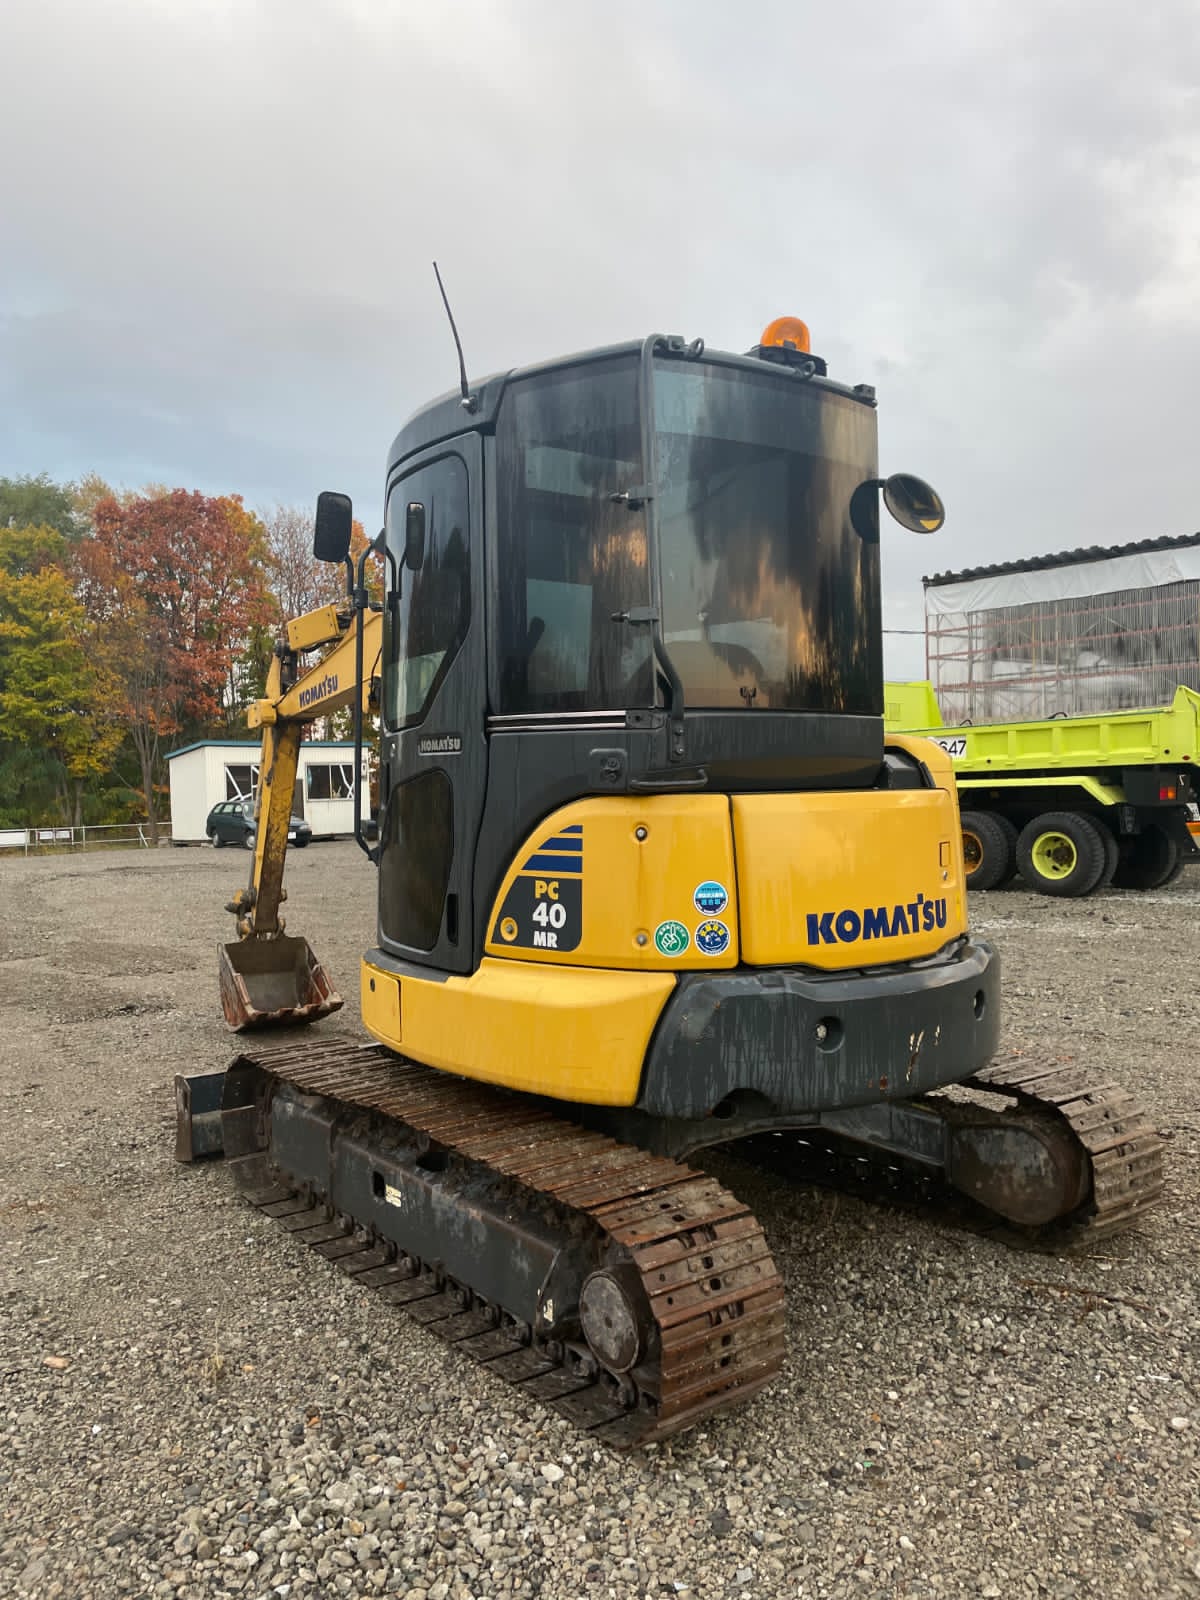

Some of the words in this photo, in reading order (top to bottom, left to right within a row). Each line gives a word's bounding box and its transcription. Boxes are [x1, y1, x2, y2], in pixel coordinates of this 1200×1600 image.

[299, 674, 338, 707] KOMATSU
[420, 736, 461, 752] KOMATSU
[535, 880, 560, 900] PC
[532, 902, 567, 929] 40
[806, 893, 947, 946] KOMATSU
[533, 930, 558, 948] MR
